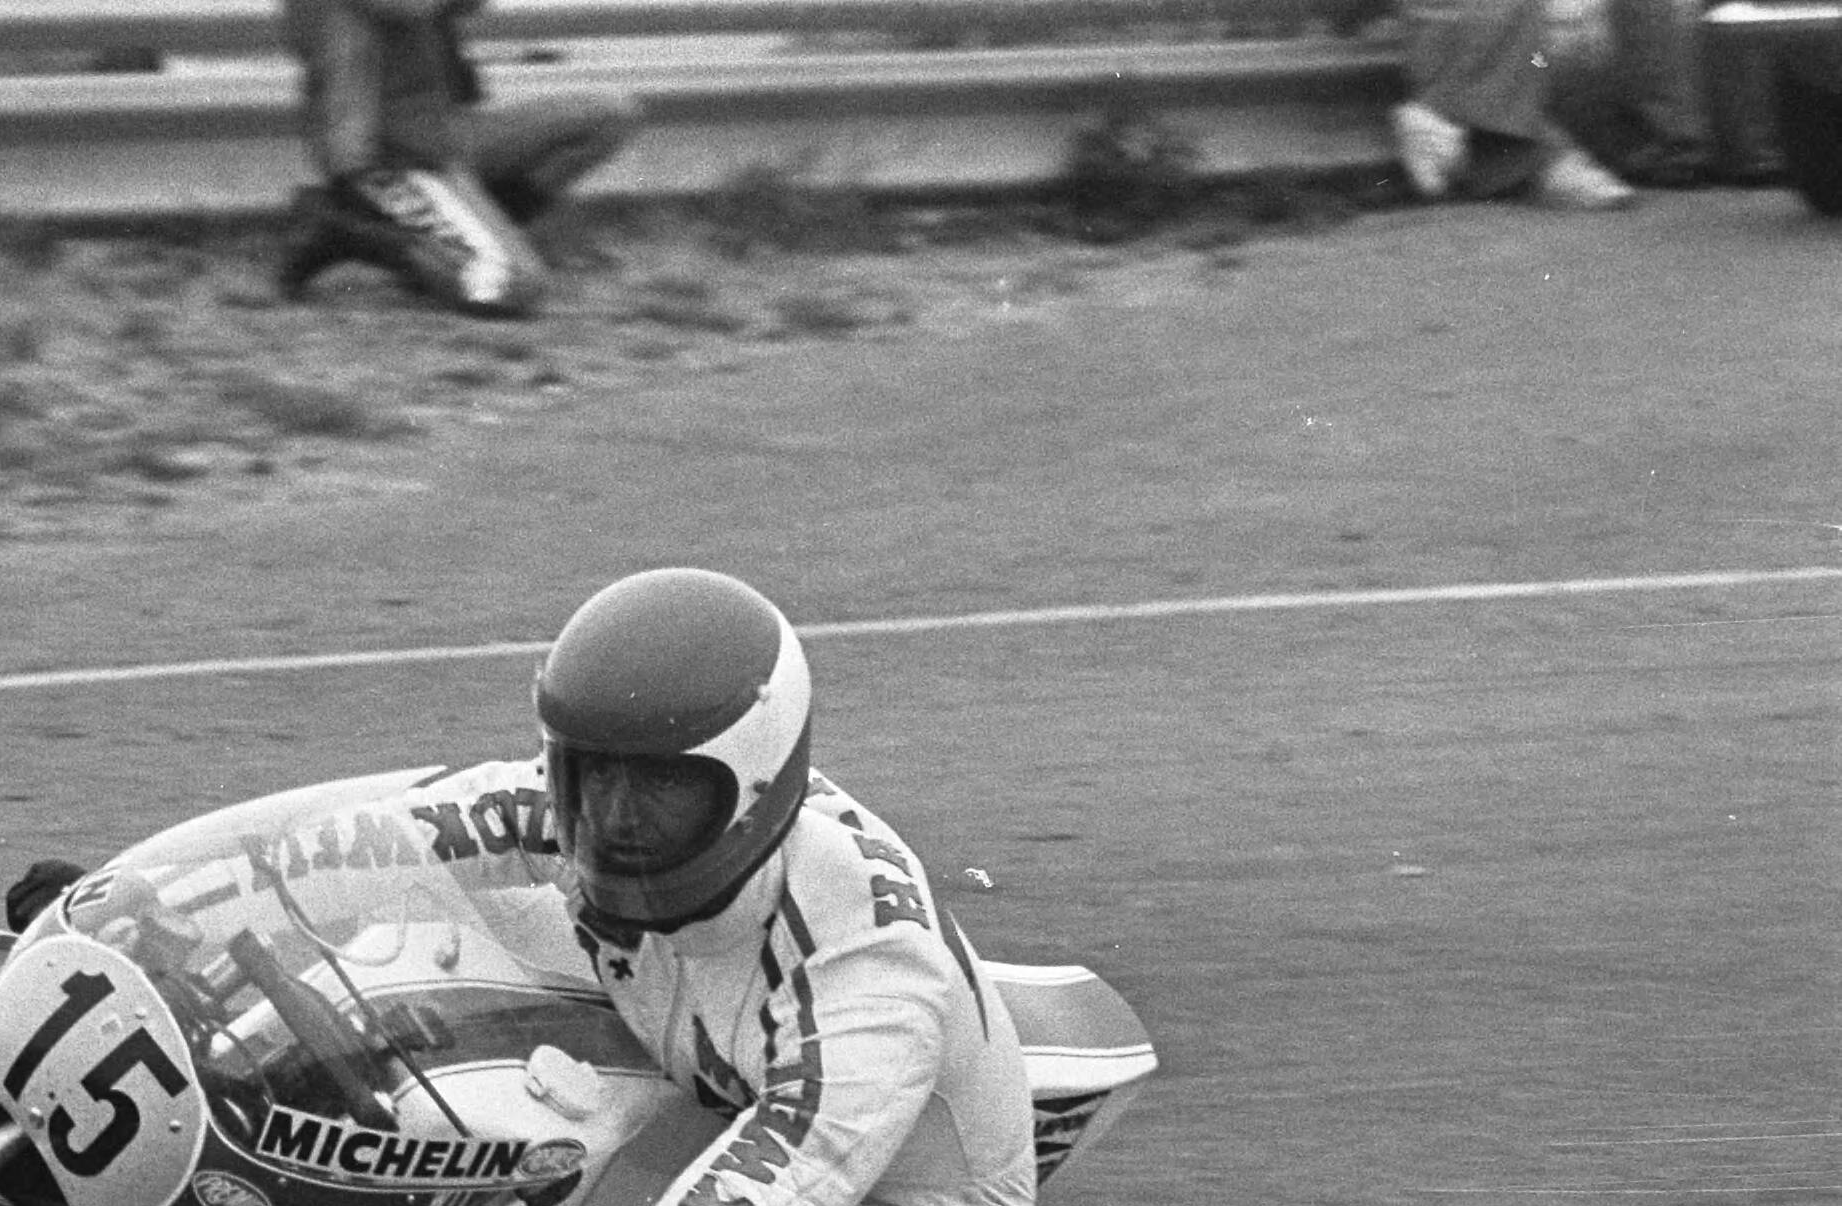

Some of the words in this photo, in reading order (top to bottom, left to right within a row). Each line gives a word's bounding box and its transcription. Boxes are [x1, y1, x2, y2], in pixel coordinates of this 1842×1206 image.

[241, 787, 559, 889] LOKWELL
[3, 971, 188, 1177] 15
[260, 1107, 528, 1181] MICHELIN
